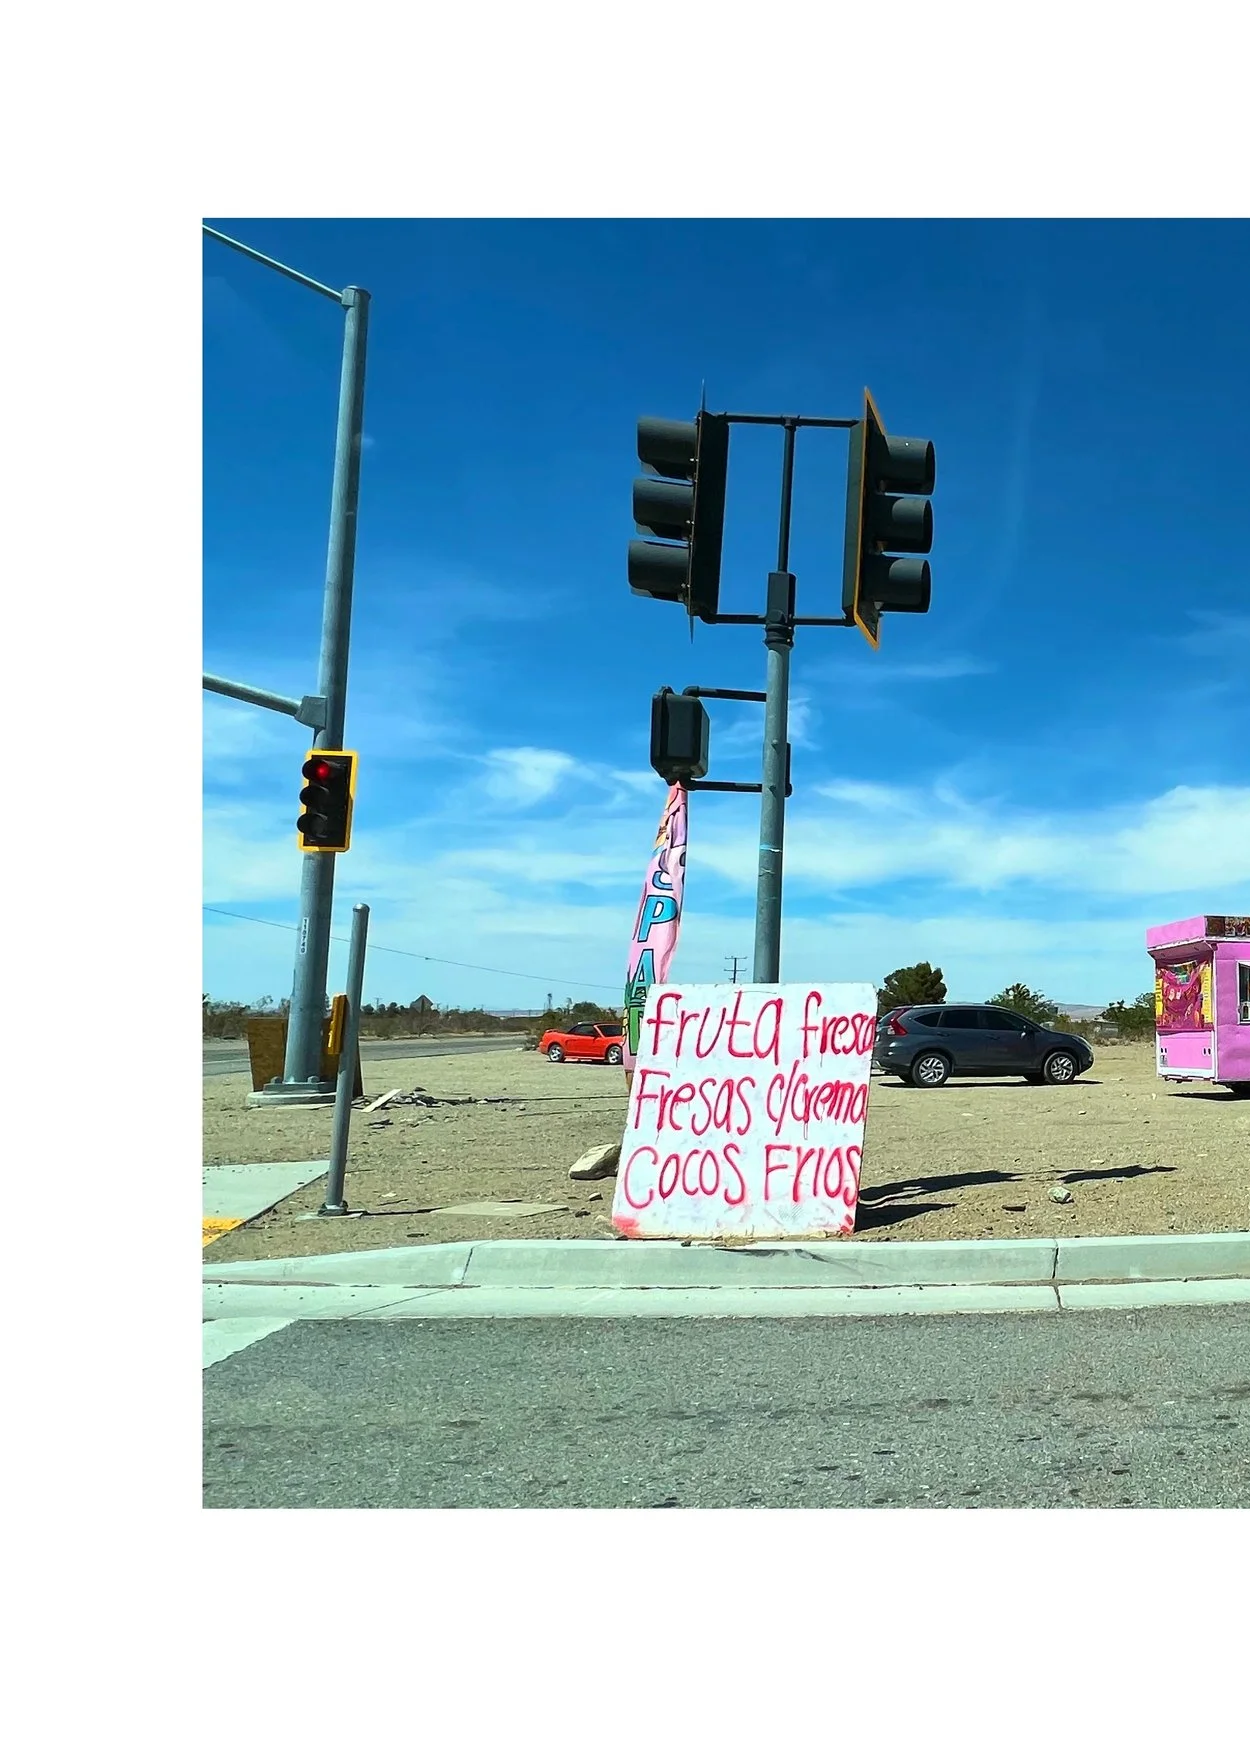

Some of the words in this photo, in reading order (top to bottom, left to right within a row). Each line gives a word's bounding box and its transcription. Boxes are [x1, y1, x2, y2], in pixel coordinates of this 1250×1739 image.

[647, 990, 783, 1065] fruta
[635, 1068, 756, 1136] Fresas
[624, 1142, 746, 1209] Cocos
